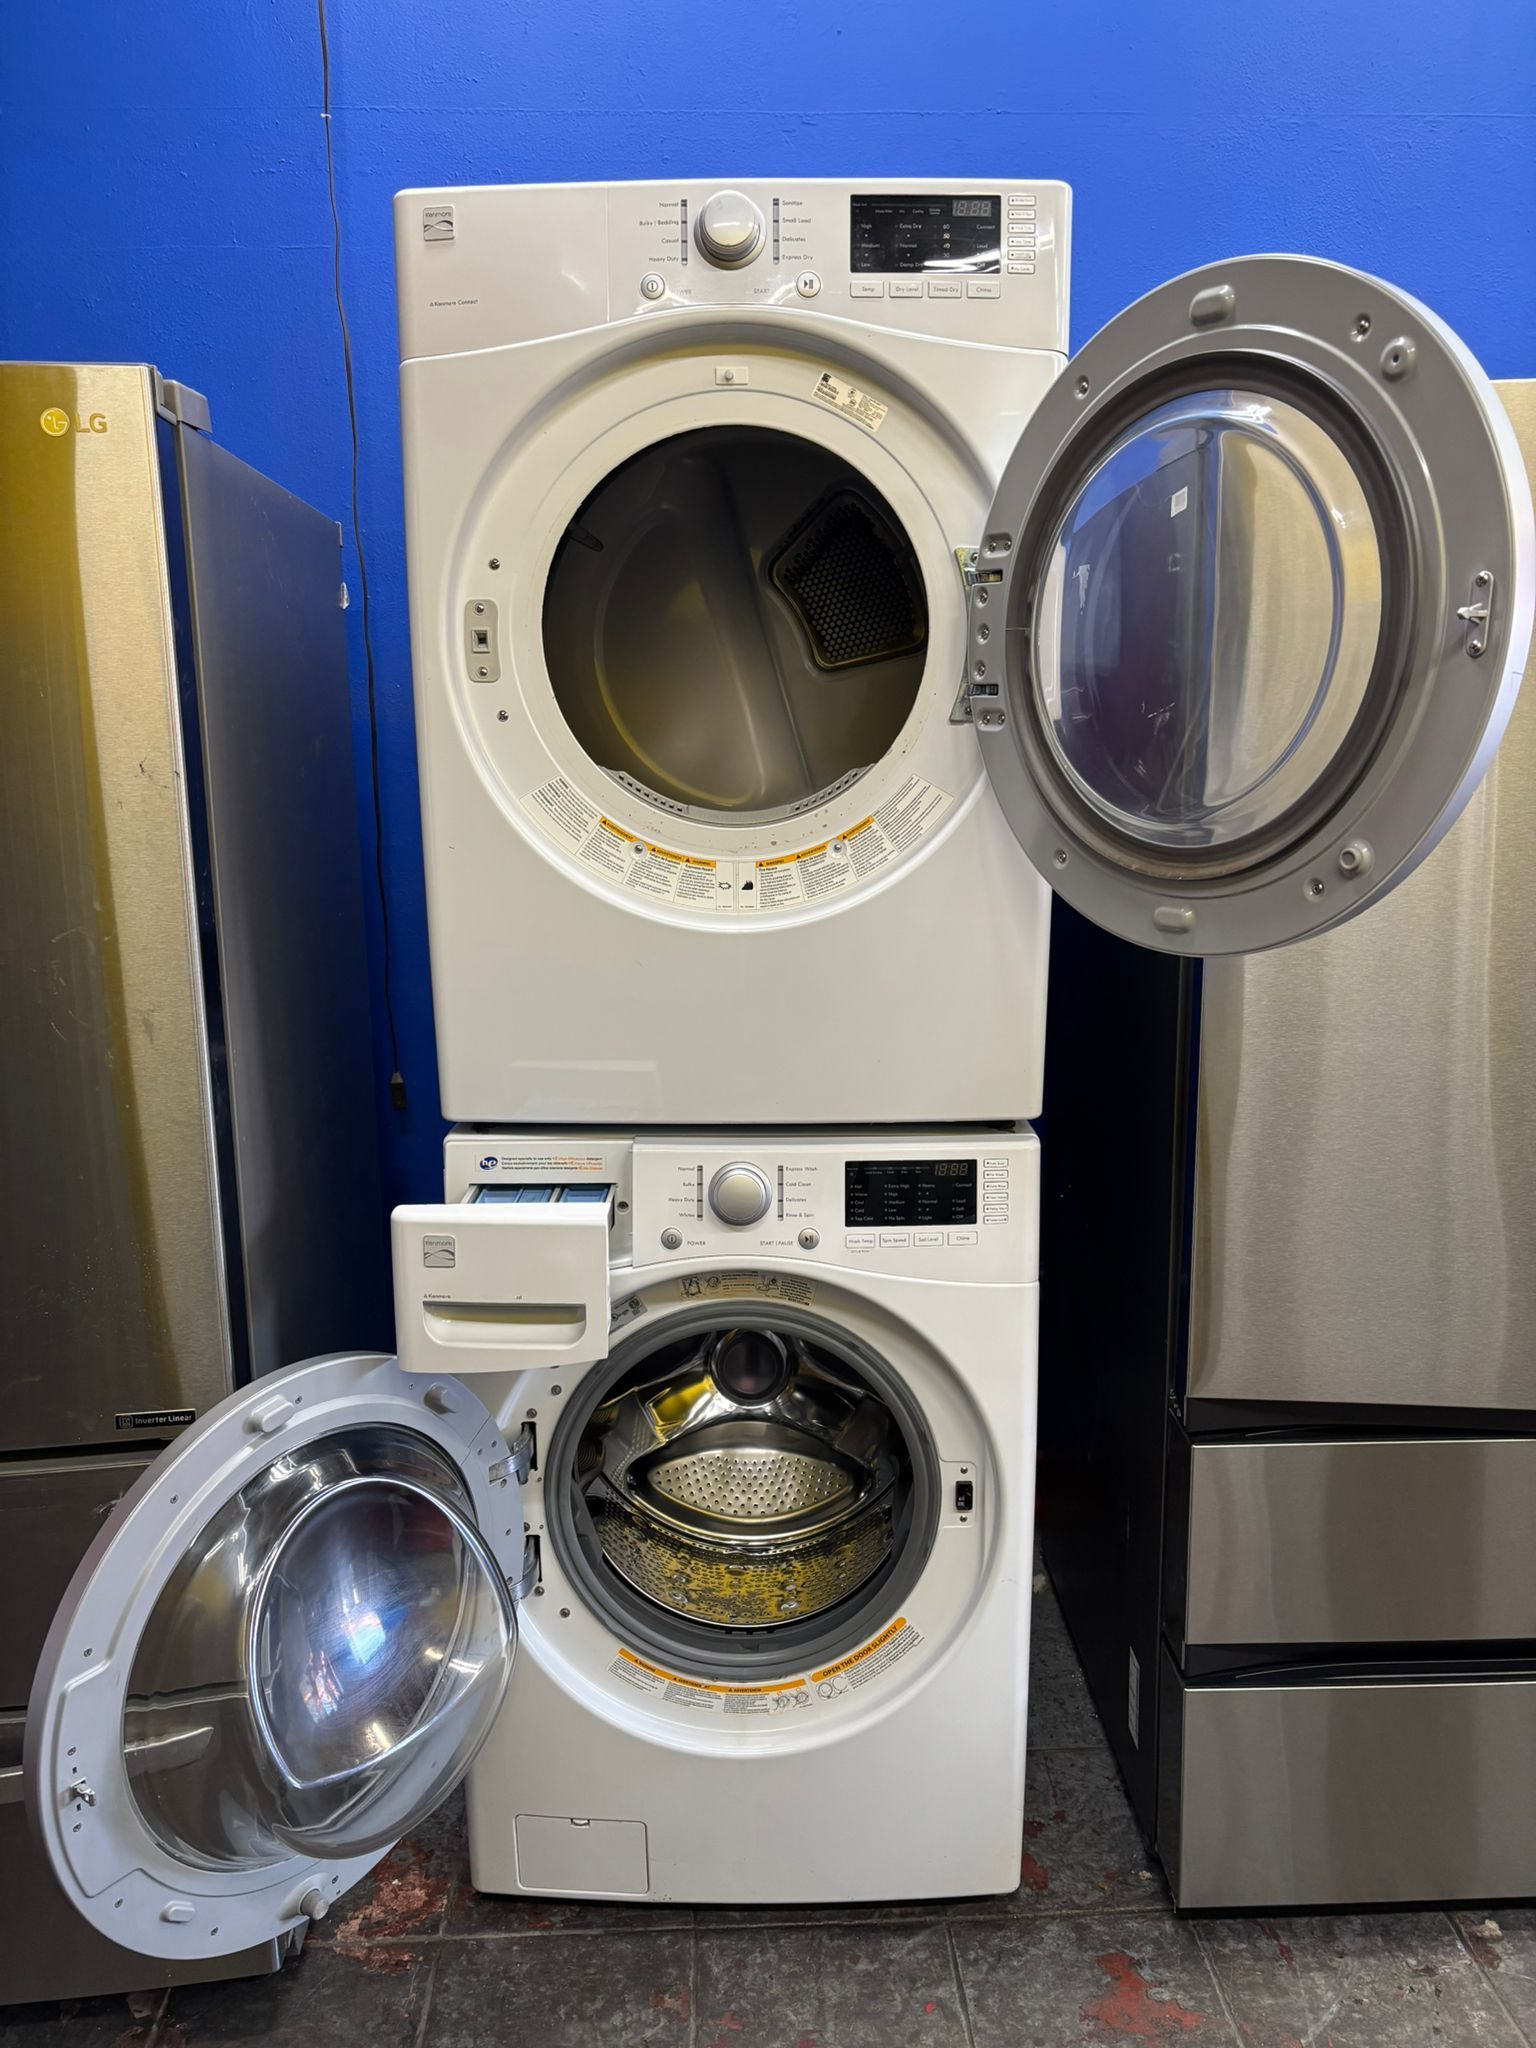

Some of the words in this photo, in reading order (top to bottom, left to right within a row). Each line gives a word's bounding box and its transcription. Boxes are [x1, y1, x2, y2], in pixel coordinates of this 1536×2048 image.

[75, 412, 108, 433] LG
[135, 1416, 167, 1424] Inverter
[822, 1665, 841, 1678] OPEN
[840, 1659, 853, 1669] THE
[853, 1646, 872, 1661] DOOR
[871, 1625, 898, 1649] SLIGHTLY
